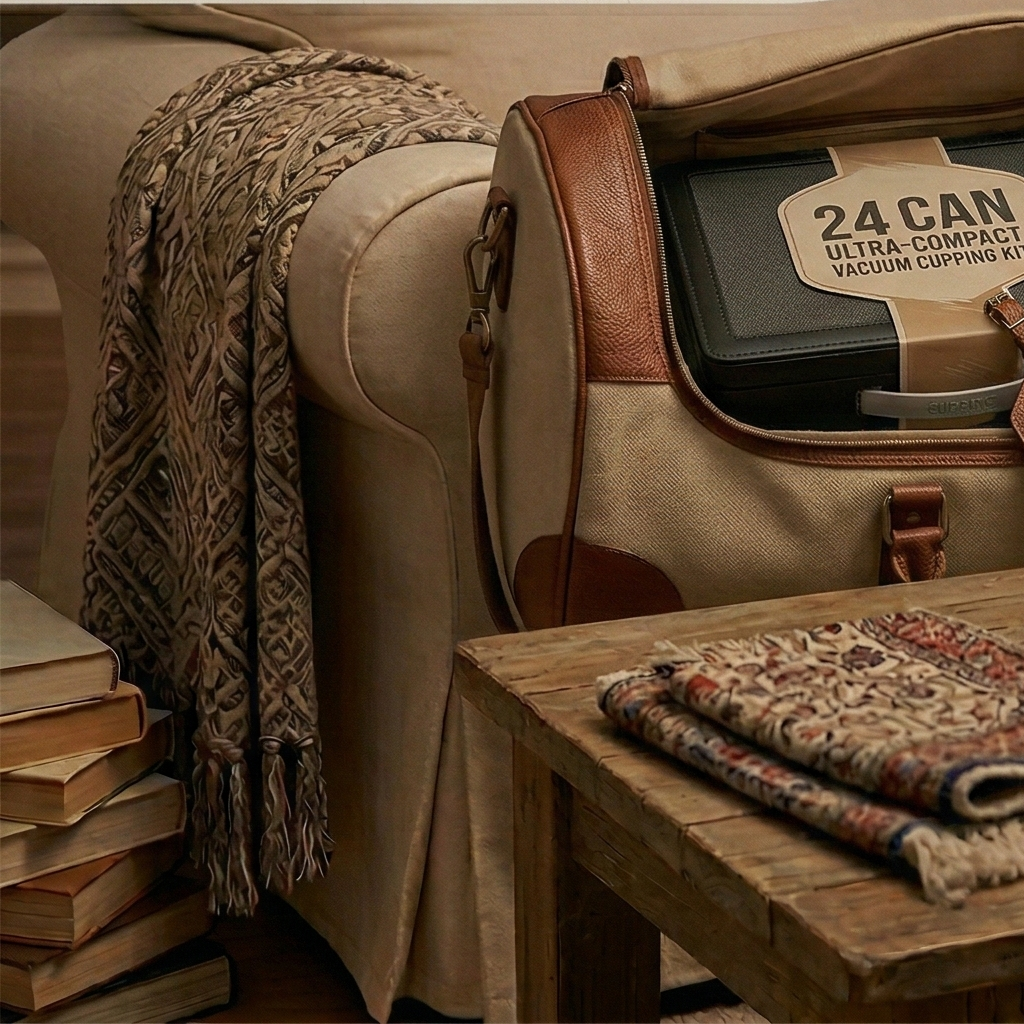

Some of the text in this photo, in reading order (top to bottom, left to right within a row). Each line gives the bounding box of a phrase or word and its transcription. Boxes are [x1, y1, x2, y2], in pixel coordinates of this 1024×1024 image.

[814, 188, 1016, 241] 24 CAN
[825, 226, 1023, 260] ULTRA-COMPACT
[832, 257, 912, 277] VACUUM
[916, 249, 997, 270] CUPPING
